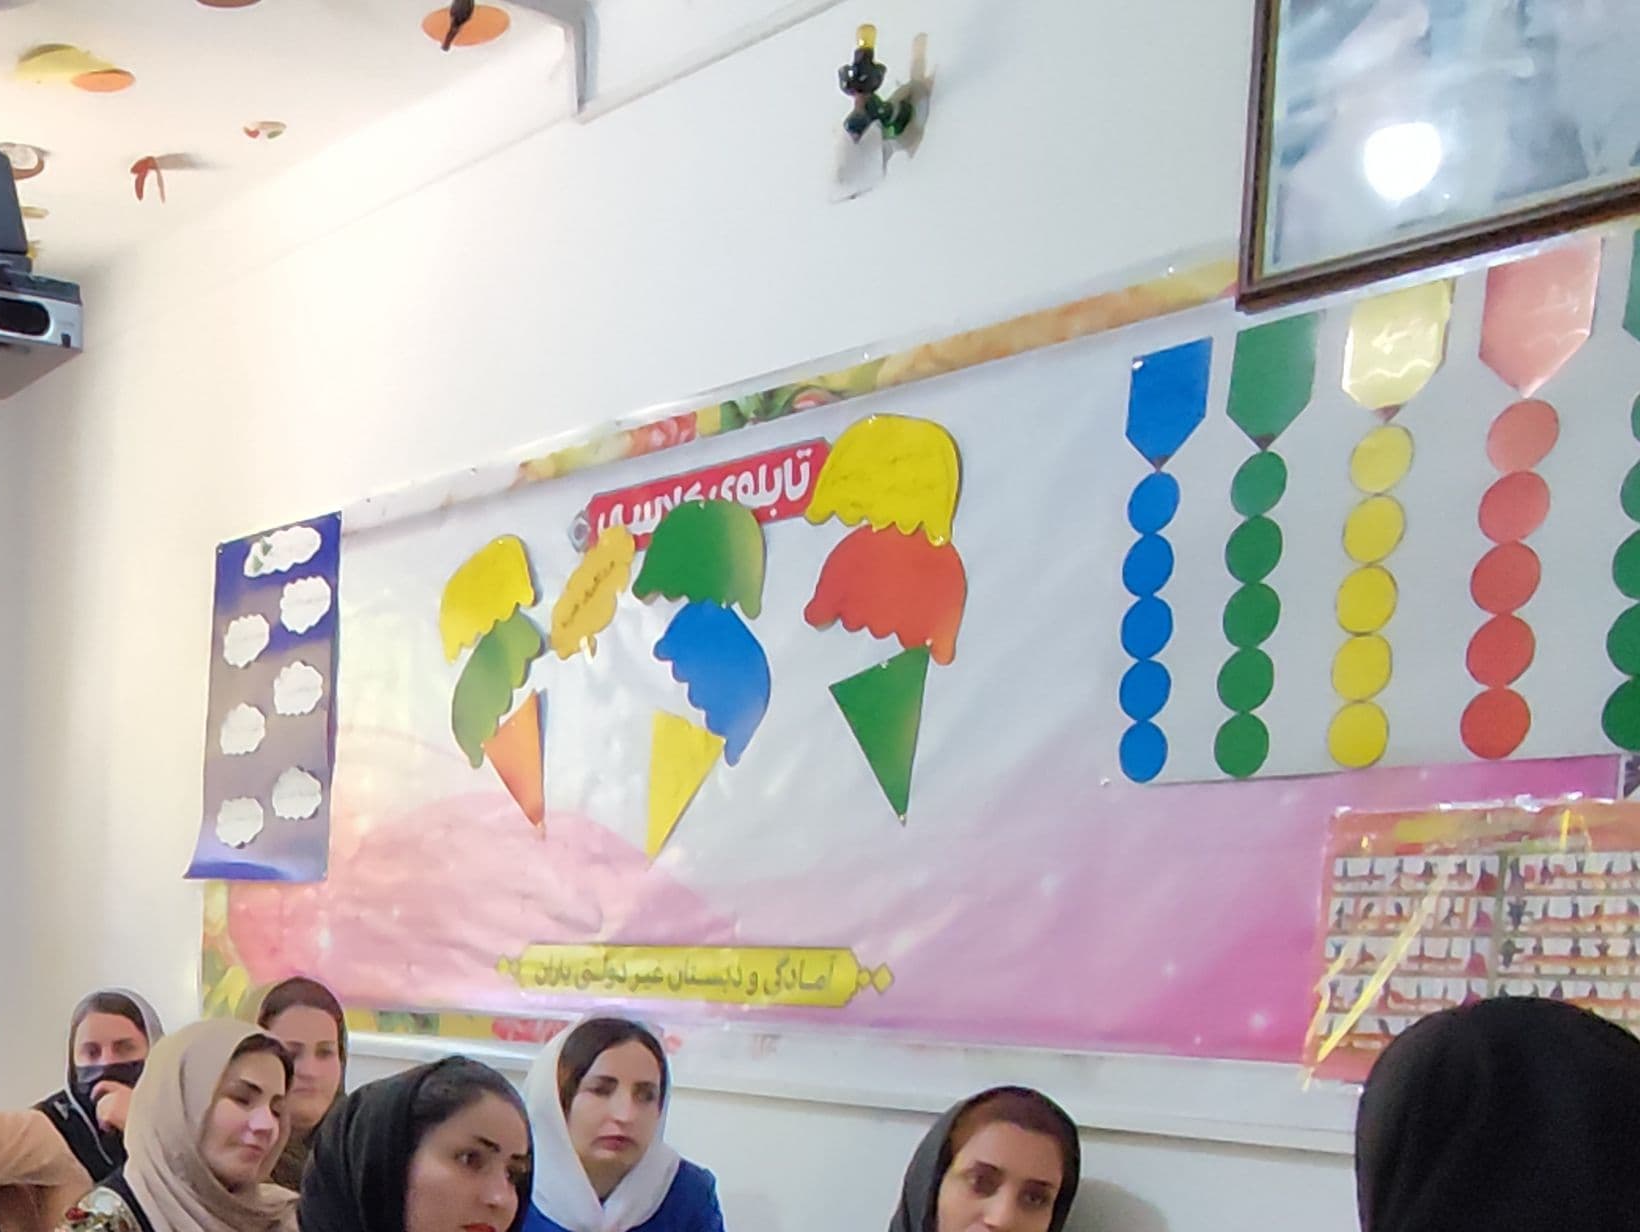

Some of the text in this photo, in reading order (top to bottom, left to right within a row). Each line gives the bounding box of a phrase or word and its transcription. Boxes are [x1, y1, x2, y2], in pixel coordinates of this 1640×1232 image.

[667, 957, 742, 993] دبستان
[745, 971, 759, 996] و
[763, 954, 837, 995] آمادگی
